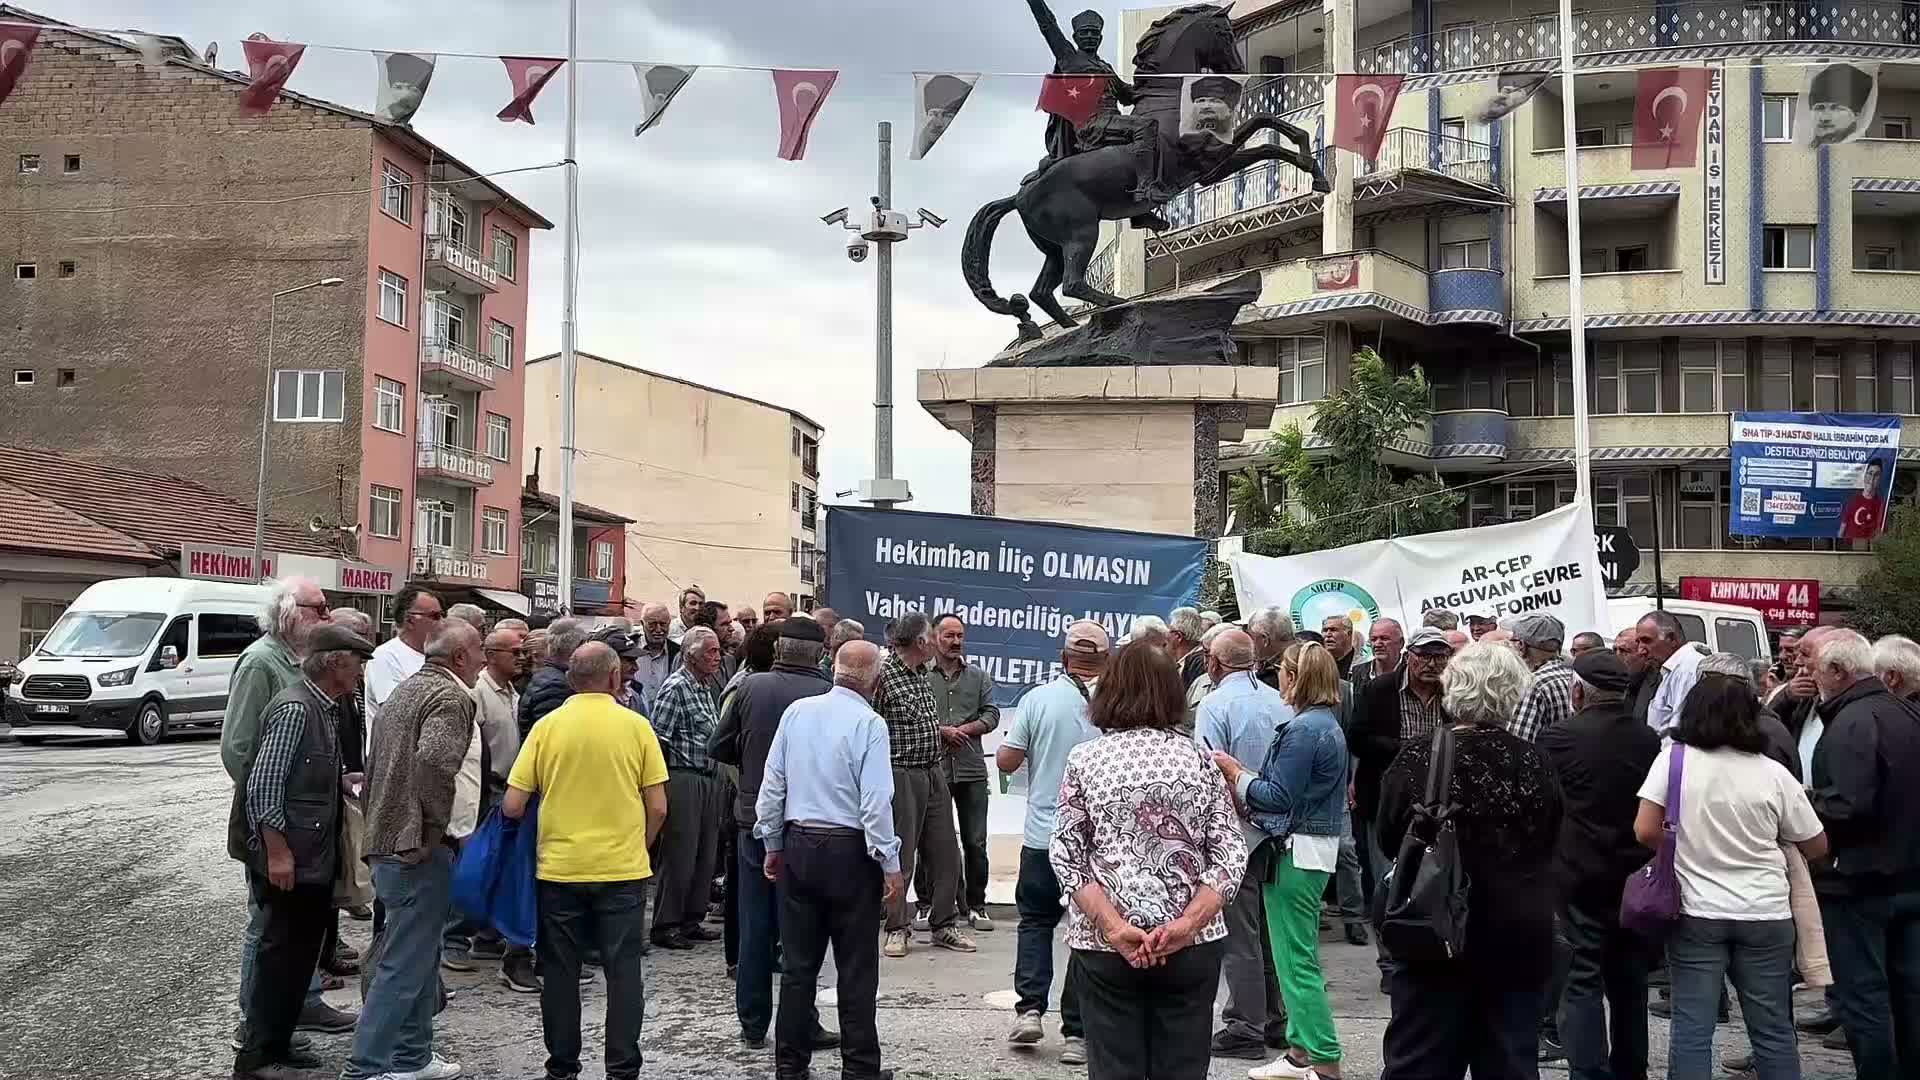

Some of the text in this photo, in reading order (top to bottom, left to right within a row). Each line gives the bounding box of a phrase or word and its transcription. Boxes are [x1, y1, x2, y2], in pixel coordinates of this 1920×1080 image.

[189, 550, 393, 590] HEKİMHN MARKET
[875, 537, 1151, 585] Hekimhan İliç OLMASIN
[1461, 554, 1533, 585] AR-ÇEP
[1420, 562, 1582, 615] ARGUVAN ÇEVRE
[1710, 581, 1780, 600] KAHVALTICIM
[1787, 584, 1809, 607] 44
[933, 596, 1075, 638] Madenciliğe
